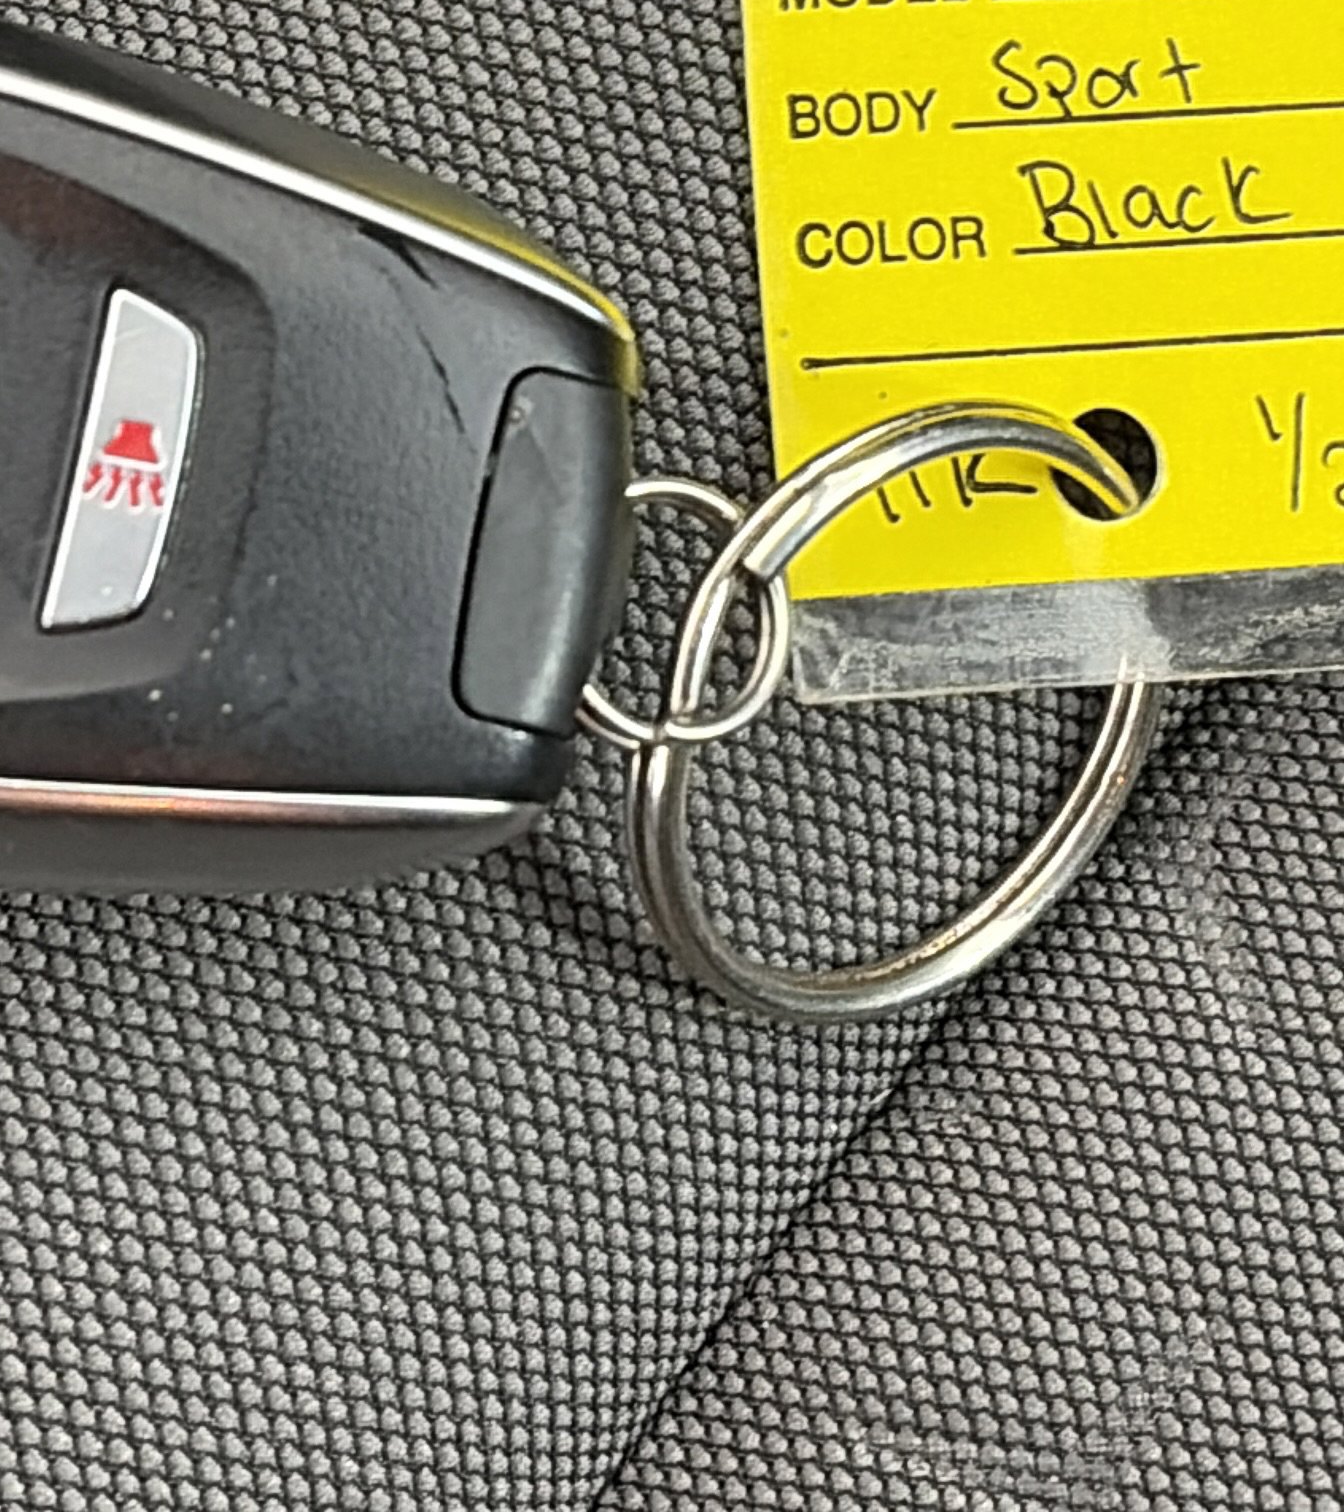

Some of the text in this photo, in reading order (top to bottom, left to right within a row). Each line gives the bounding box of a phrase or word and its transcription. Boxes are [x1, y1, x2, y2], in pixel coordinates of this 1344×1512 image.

[992, 39, 1202, 118] Sport
[788, 90, 937, 140] BODY
[1017, 158, 1292, 248] Black
[796, 216, 986, 269] COLOR
